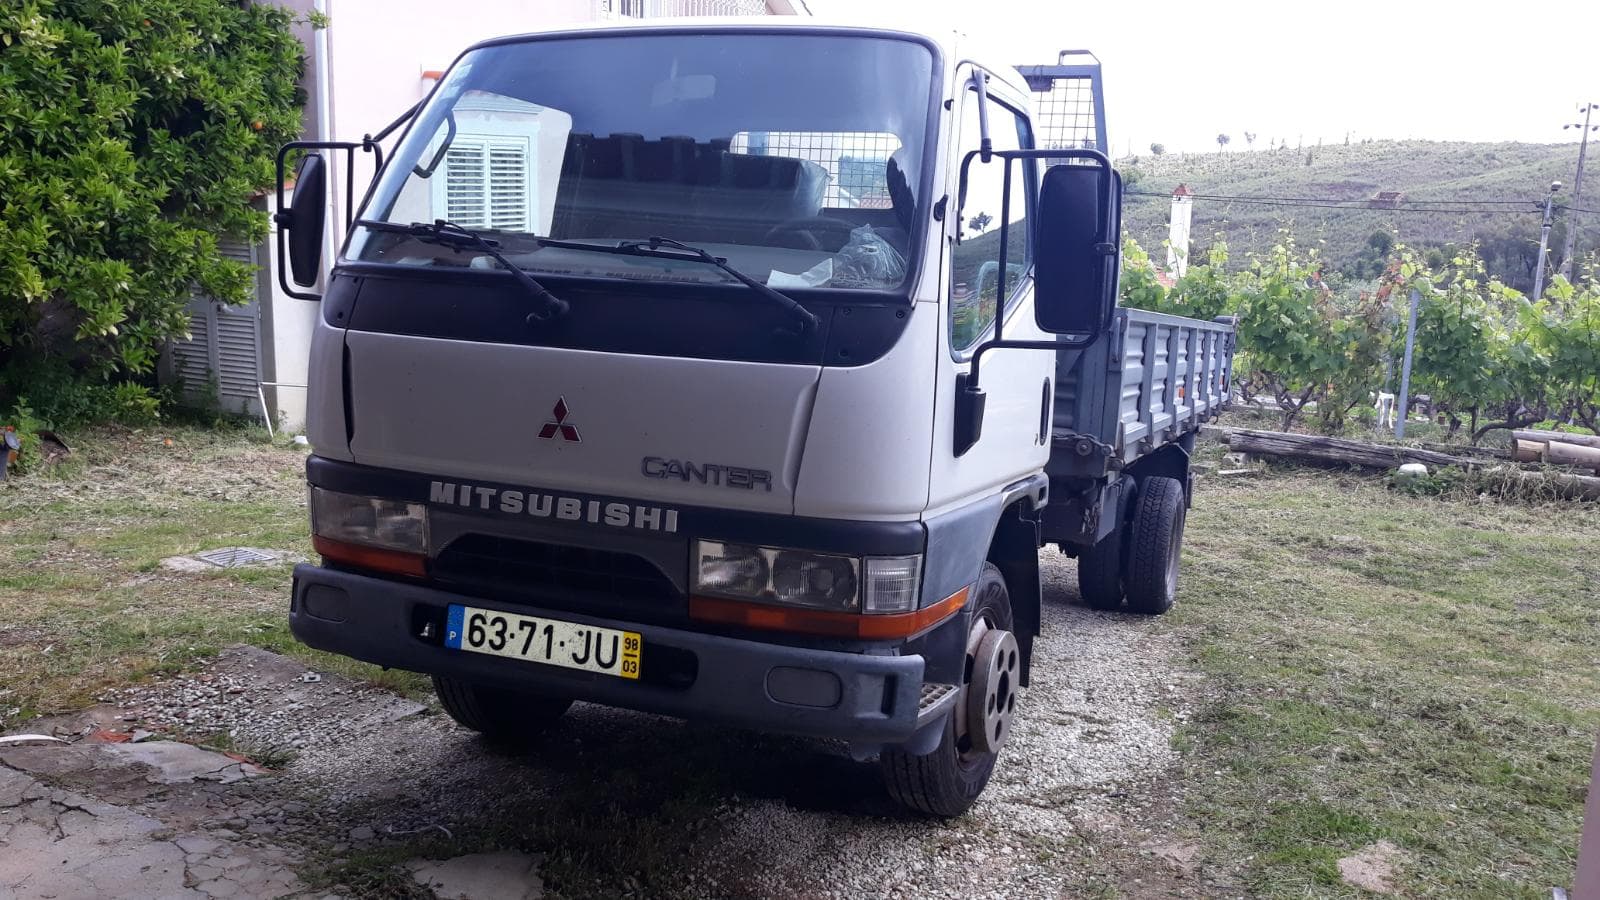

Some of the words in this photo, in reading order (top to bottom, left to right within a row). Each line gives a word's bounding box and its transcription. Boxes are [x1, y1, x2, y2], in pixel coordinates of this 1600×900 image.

[641, 456, 772, 492] CANTER
[430, 481, 679, 533] MITSUBISHI
[449, 630, 457, 641] P
[624, 637, 639, 651] 98
[622, 660, 637, 674] 03
